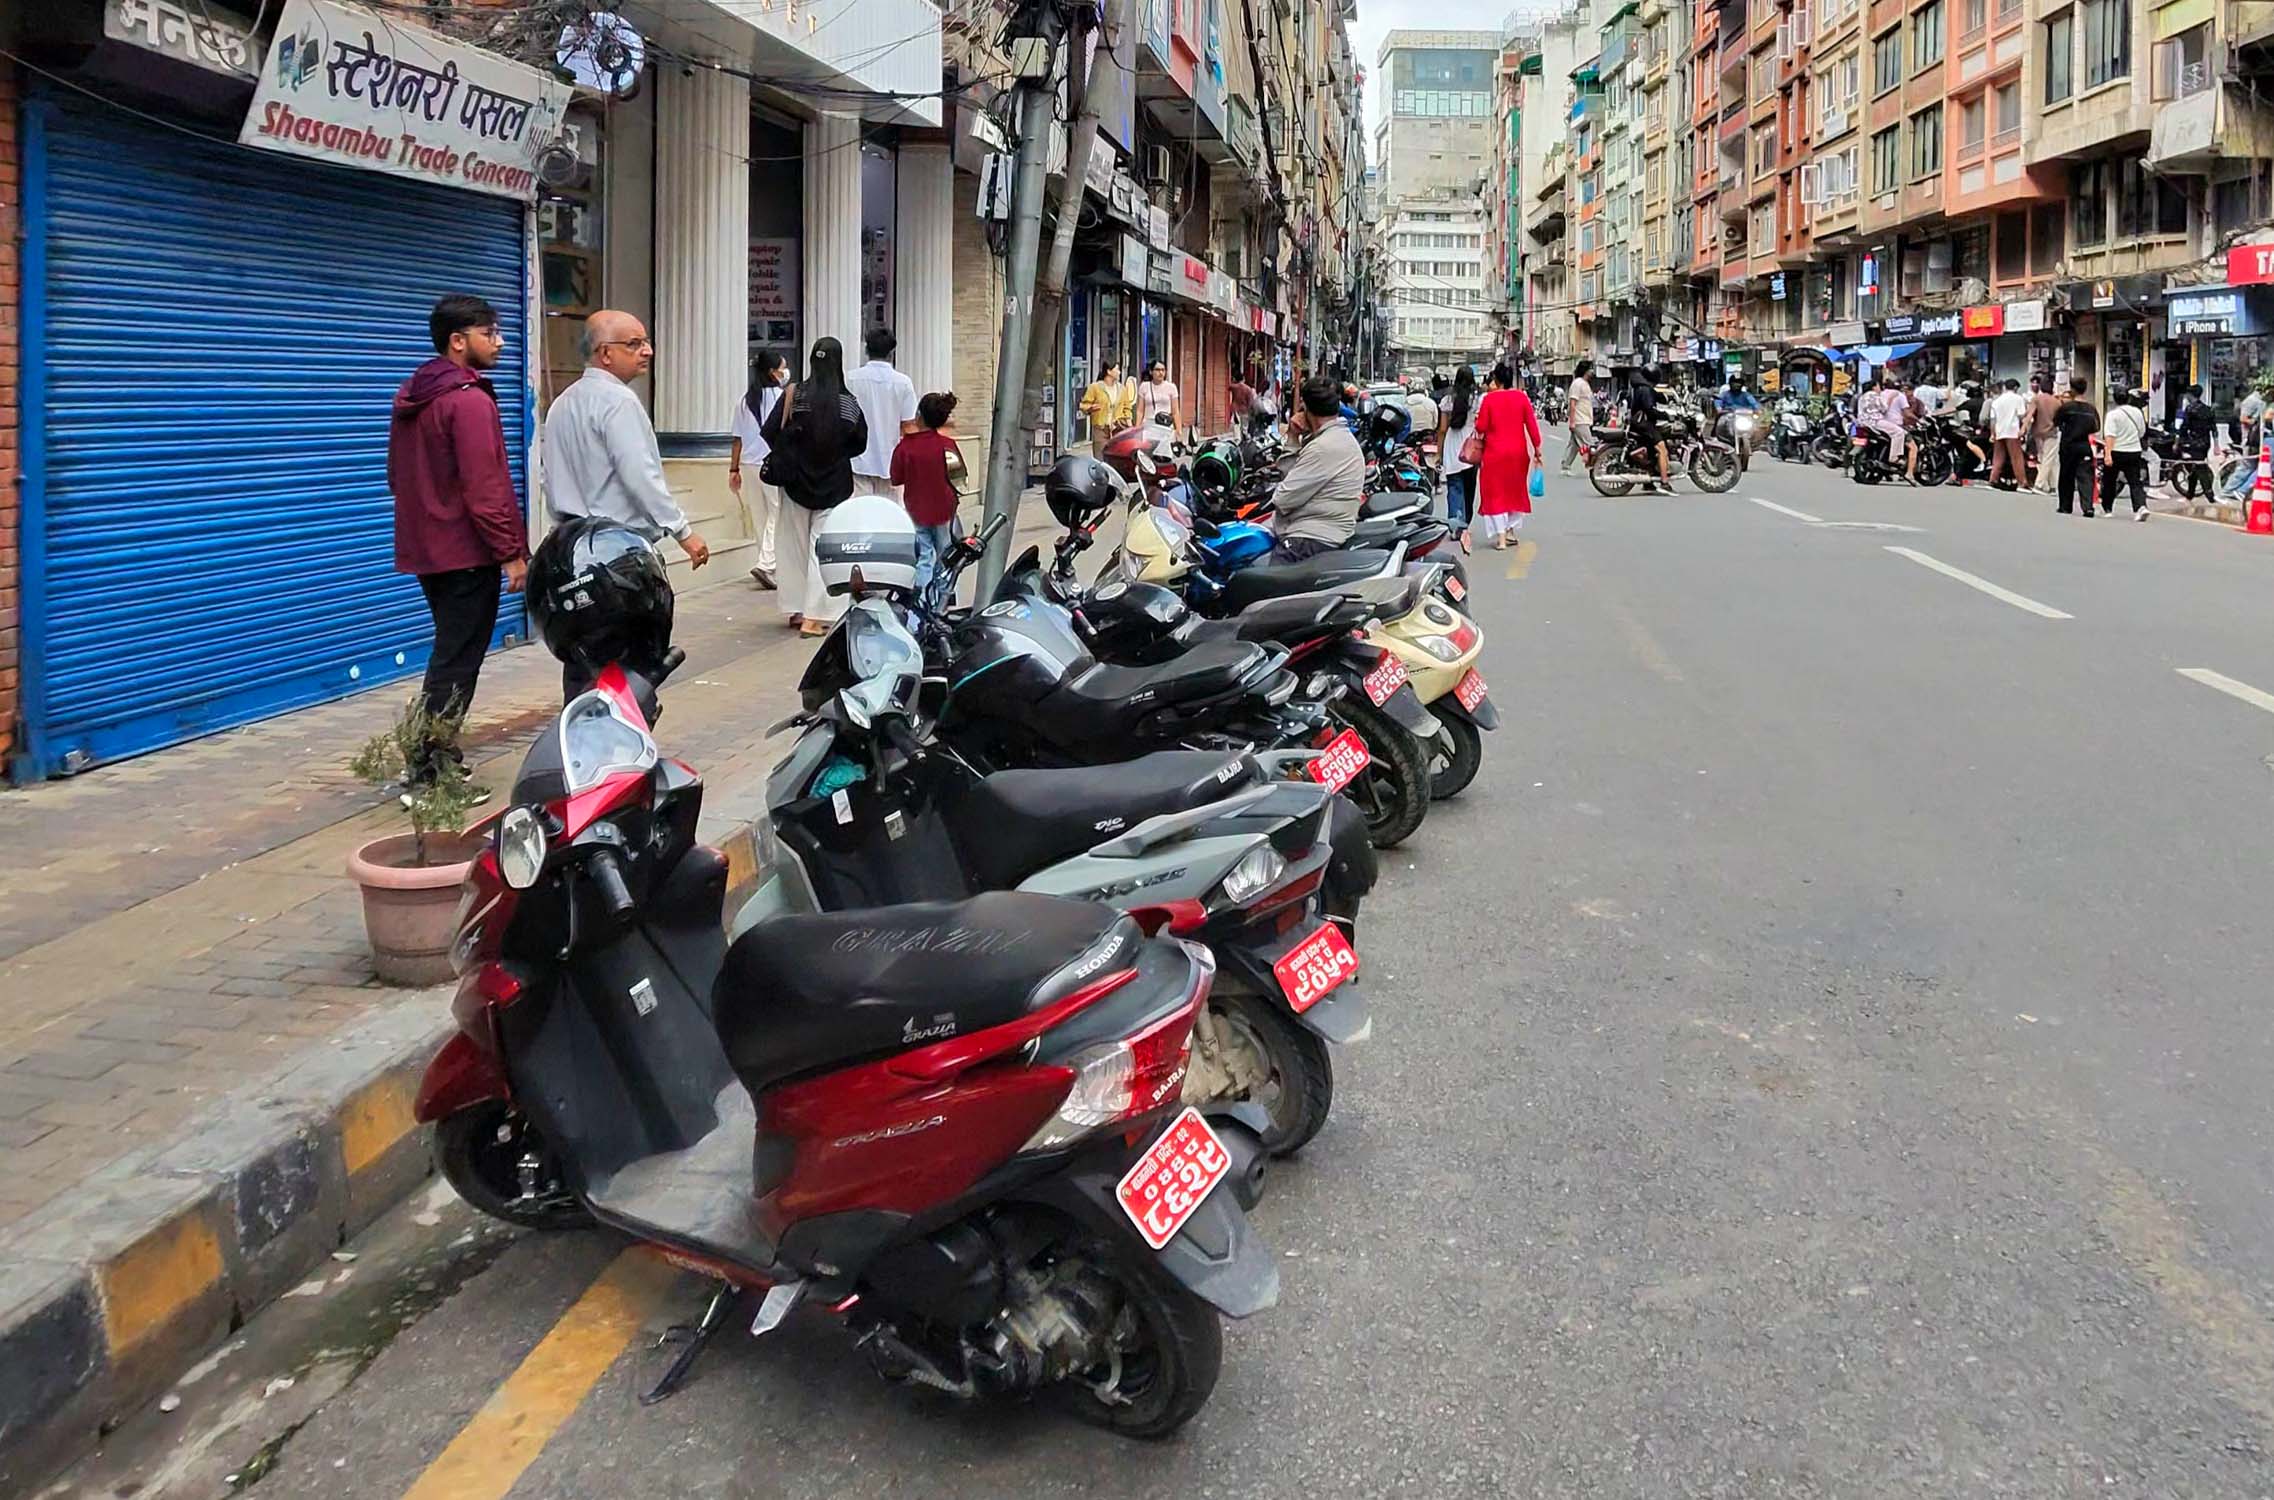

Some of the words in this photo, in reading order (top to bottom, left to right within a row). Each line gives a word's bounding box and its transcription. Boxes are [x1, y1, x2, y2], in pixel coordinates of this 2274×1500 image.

[326, 31, 459, 122] स्टेशनरी
[460, 82, 535, 143] पसल
[258, 100, 393, 160] Shasambu
[395, 134, 457, 175] Trade
[461, 151, 533, 191] Concern
[749, 244, 782, 255] aptop
[749, 257, 781, 267] epair
[749, 282, 780, 293] epair
[2185, 319, 2217, 334] iPhone
[1374, 666, 1408, 702] ३८१२
[1216, 759, 1244, 784] BAJRA
[1074, 935, 1125, 980] HONDA
[1294, 949, 1356, 1002] ९०५१
[1151, 1066, 1186, 1102] BAJRA
[1144, 1155, 1185, 1201] ०४४
[1183, 1137, 1200, 1156] प
[1143, 1140, 1226, 1236] ८६२९
